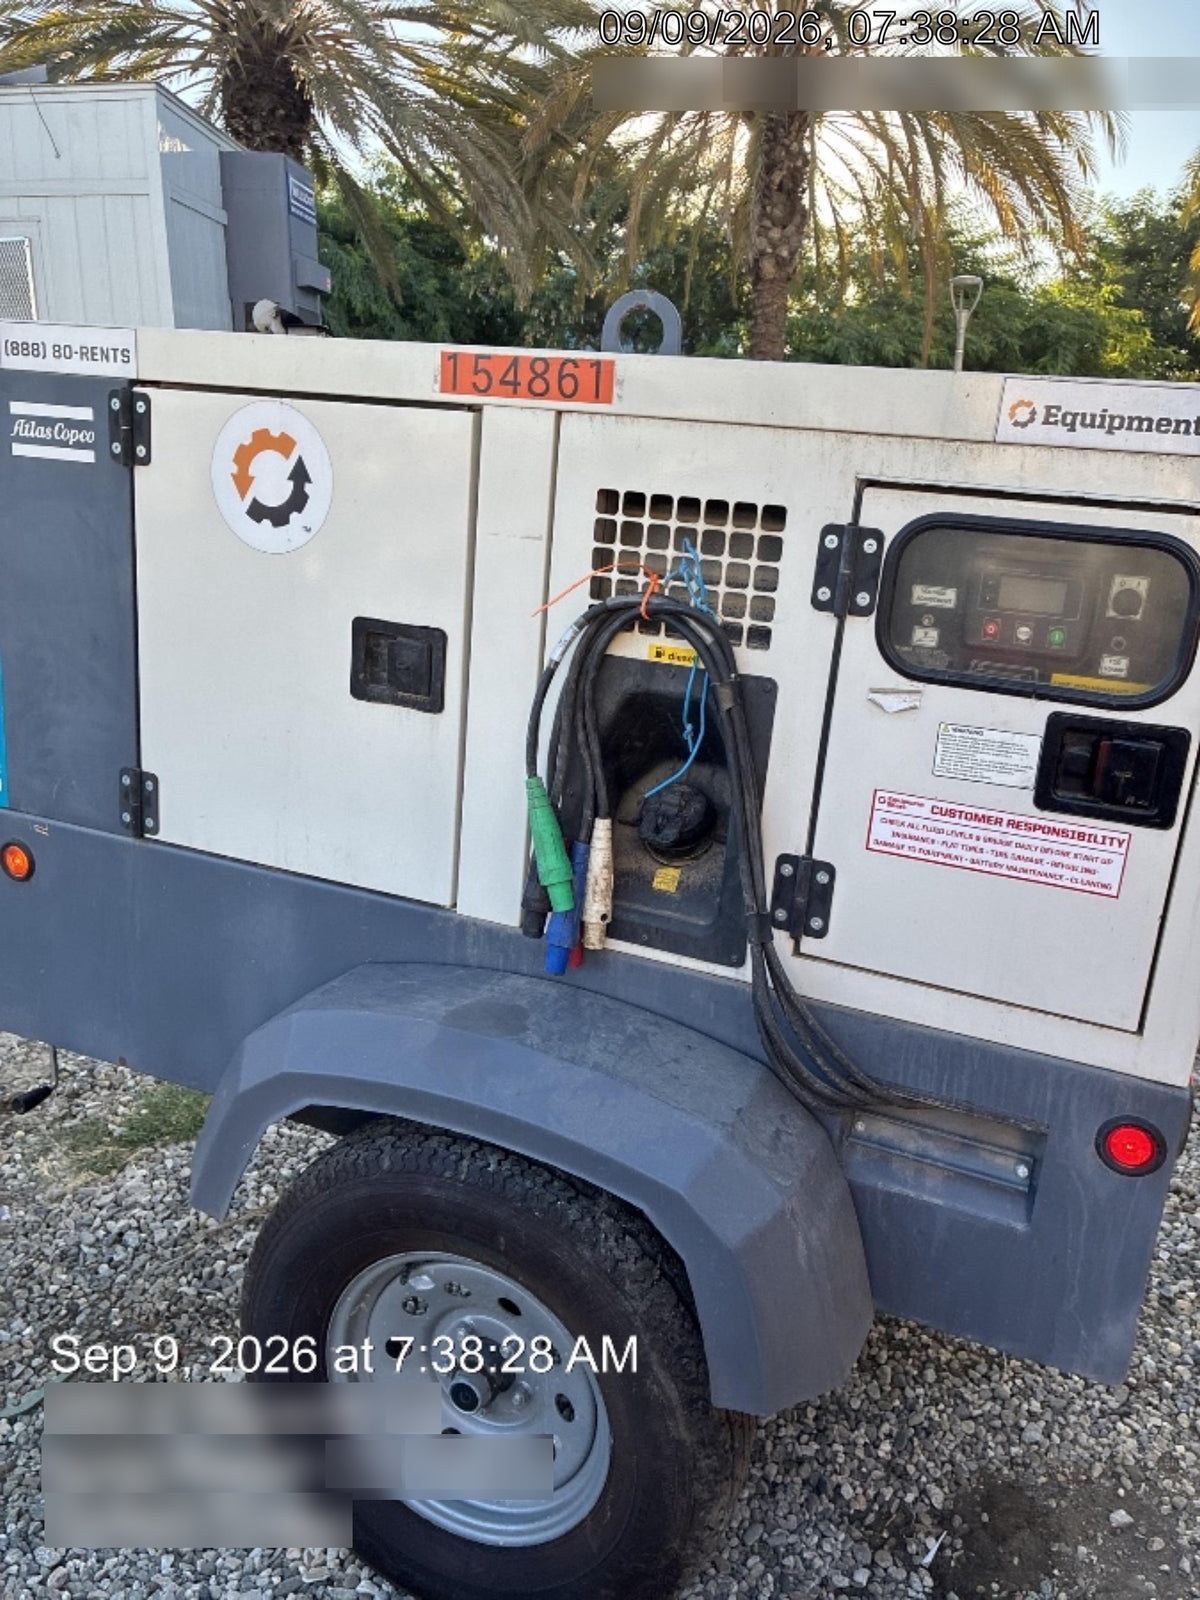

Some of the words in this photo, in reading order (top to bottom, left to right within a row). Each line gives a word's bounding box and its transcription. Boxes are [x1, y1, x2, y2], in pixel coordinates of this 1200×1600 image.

[4, 339, 47, 359] (888)
[52, 344, 130, 363] 80-RENTS
[447, 353, 604, 399] 154861
[10, 419, 52, 439] Atlas
[53, 422, 95, 445] Copco
[1041, 405, 1200, 436] Equipment
[931, 805, 1003, 826] CUSTOMER
[1006, 819, 1126, 848] RESPONSIBILITY
